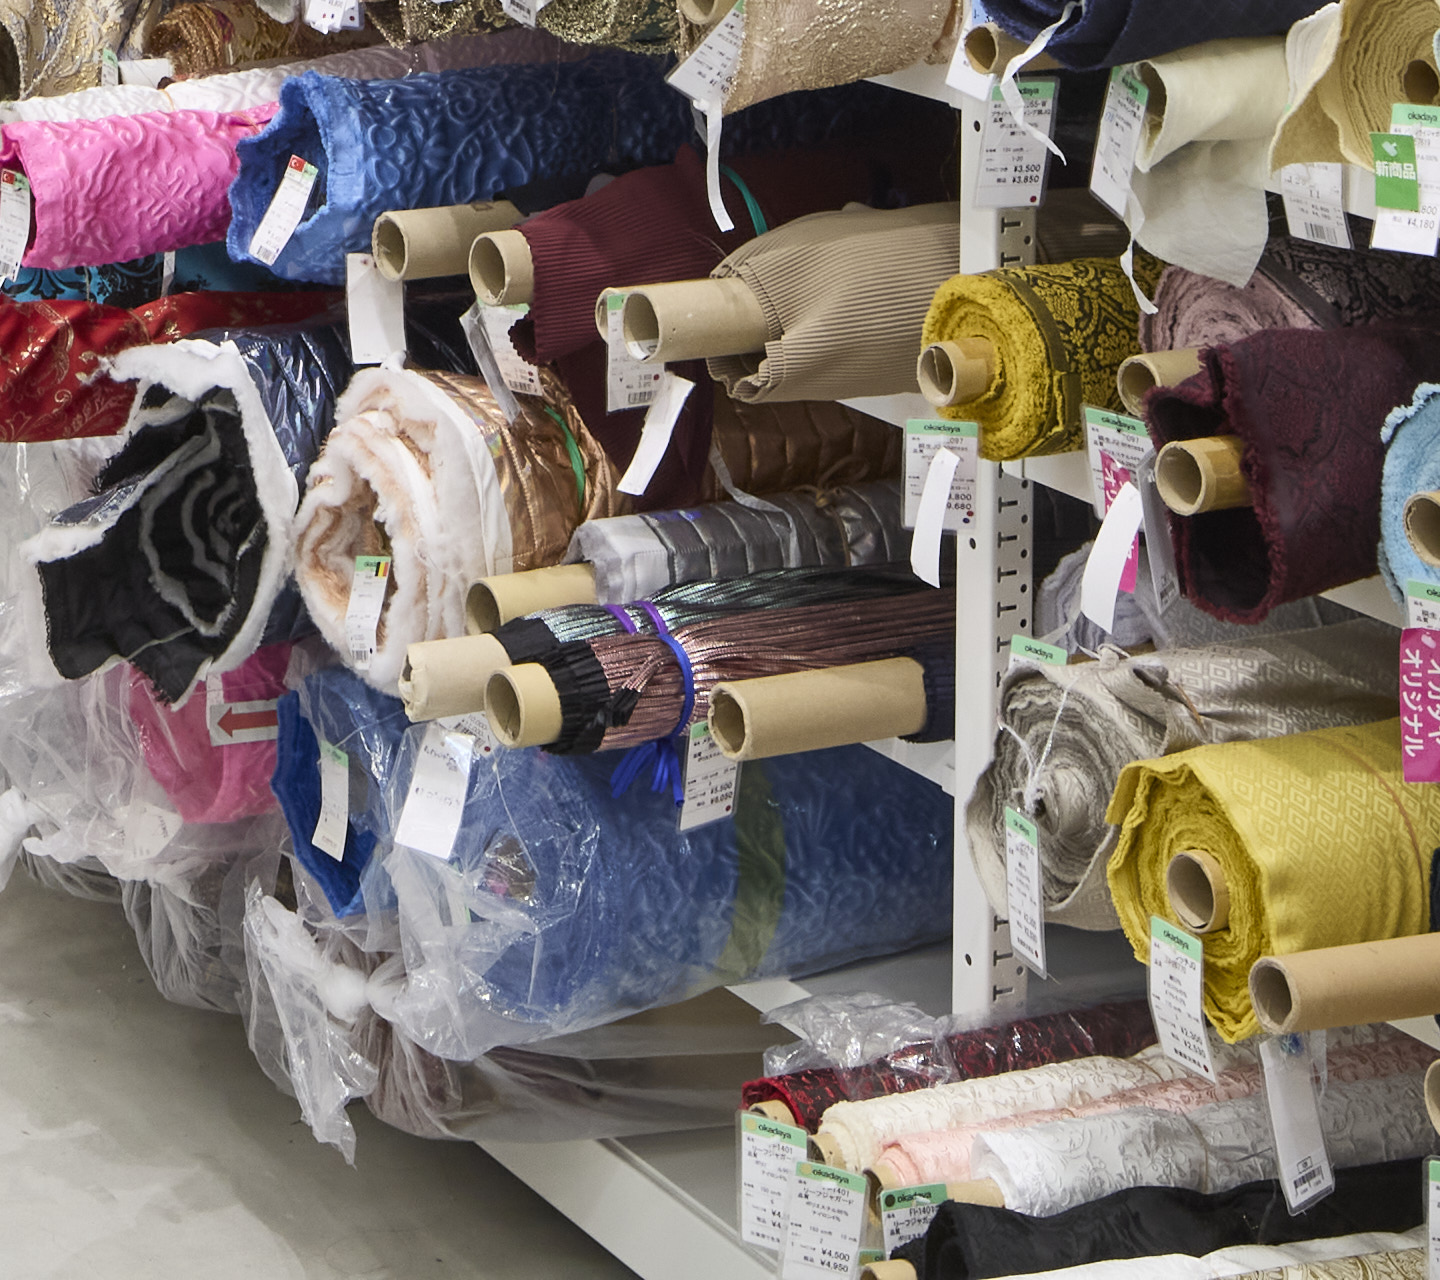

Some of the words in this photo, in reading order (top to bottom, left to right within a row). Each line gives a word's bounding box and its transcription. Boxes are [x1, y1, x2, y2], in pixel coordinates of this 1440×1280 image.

[1408, 111, 1438, 123] okadaya
[1375, 160, 1416, 180] 新商品
[924, 424, 960, 433] okadaya
[1402, 648, 1424, 757] オリジナル
[758, 1123, 792, 1139] okadaya
[812, 1168, 849, 1184] okadaya
